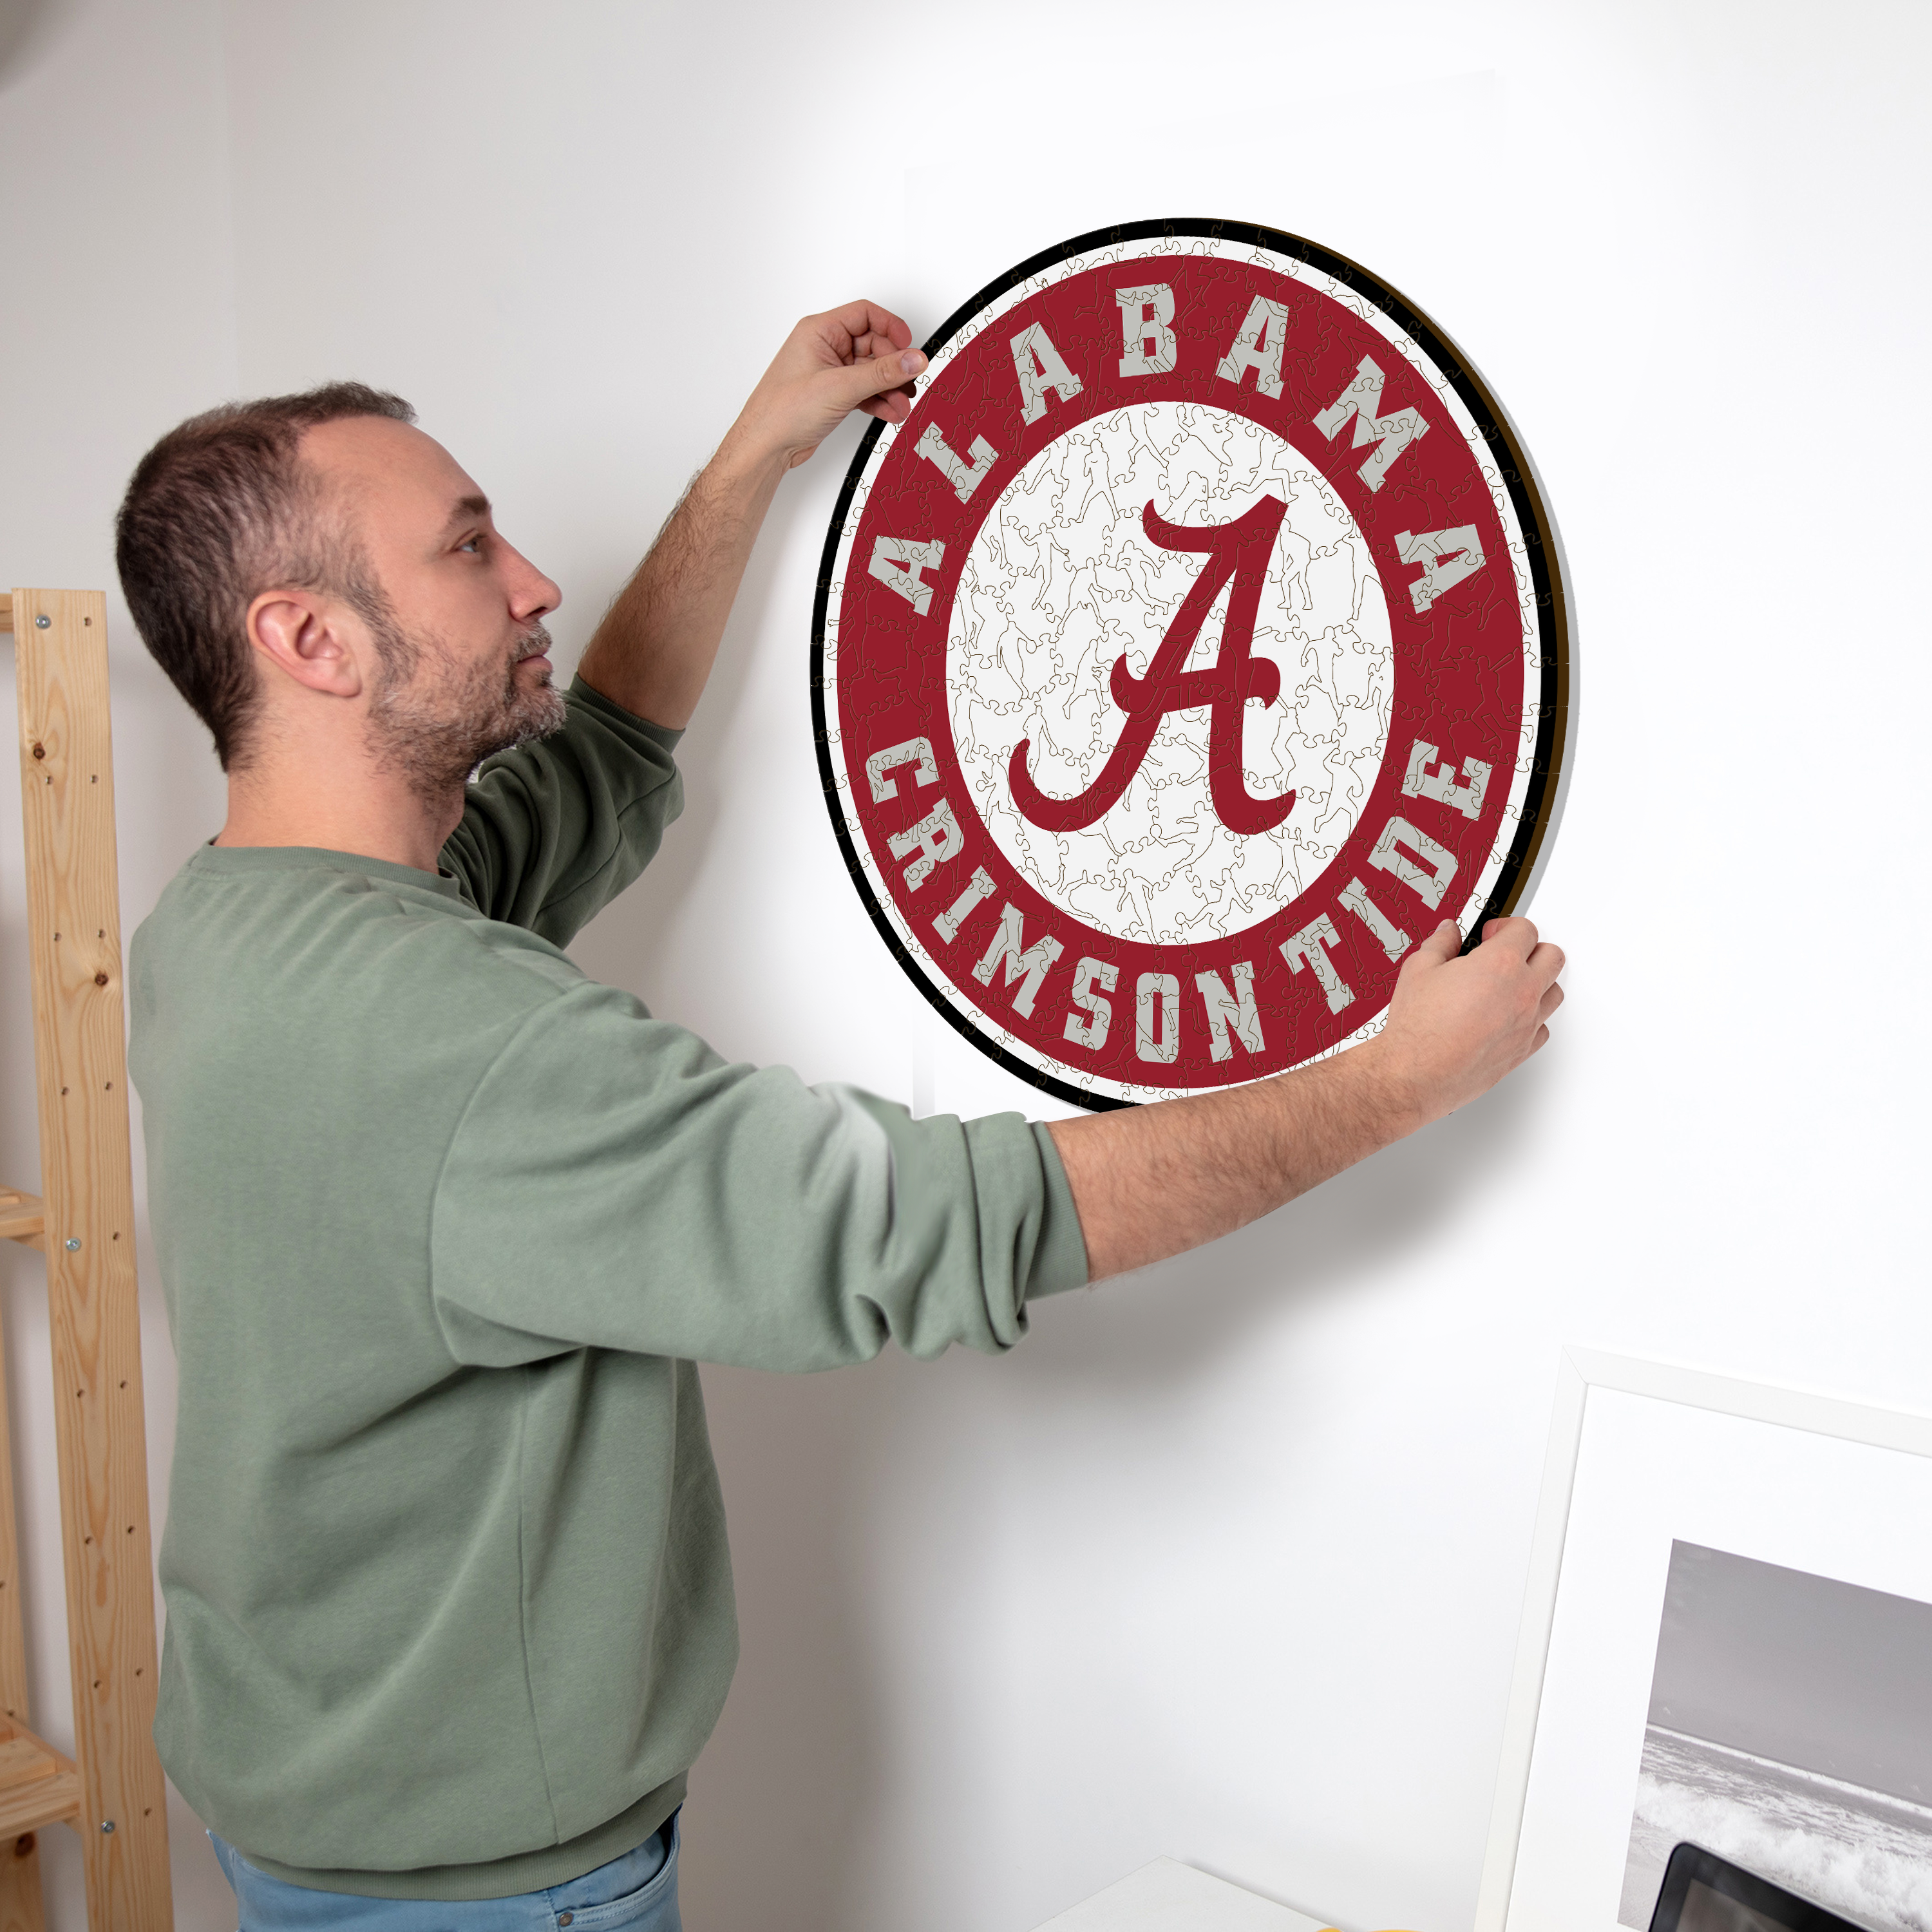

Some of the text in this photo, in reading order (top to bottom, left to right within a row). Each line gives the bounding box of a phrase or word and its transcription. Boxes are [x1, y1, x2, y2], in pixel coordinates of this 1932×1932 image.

[867, 283, 1487, 617] ALABAMA
[1009, 493, 1296, 835] A
[865, 736, 1493, 1064] CRIMSON TIDE
